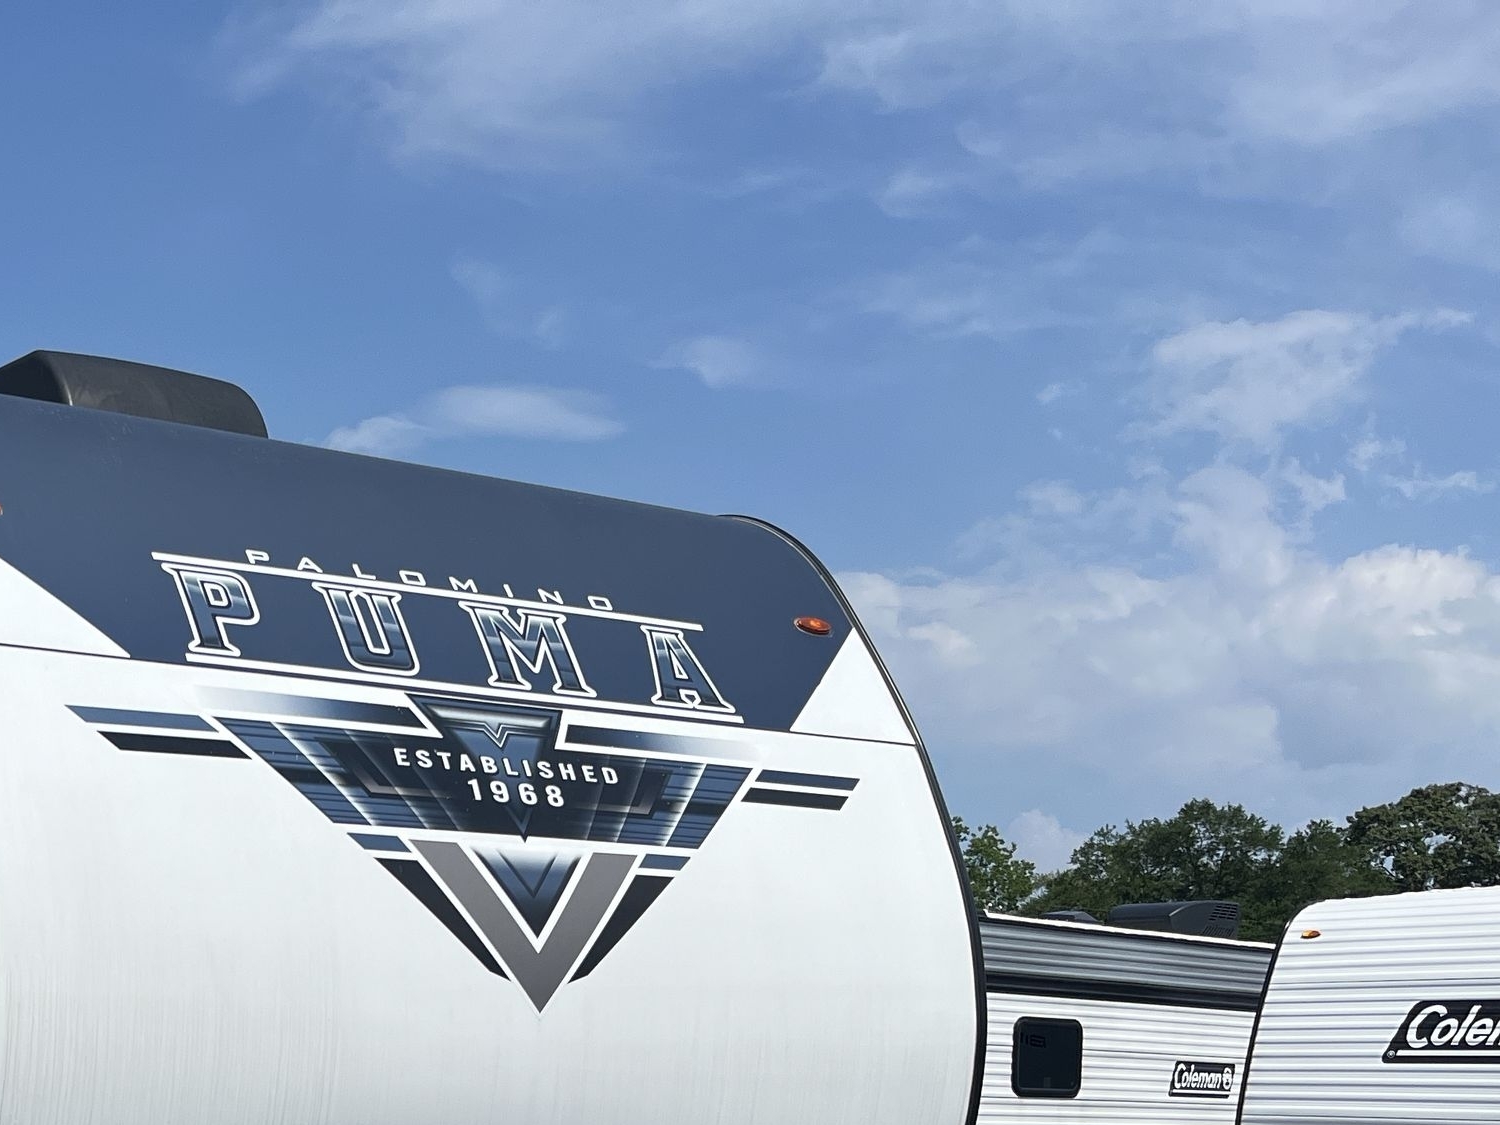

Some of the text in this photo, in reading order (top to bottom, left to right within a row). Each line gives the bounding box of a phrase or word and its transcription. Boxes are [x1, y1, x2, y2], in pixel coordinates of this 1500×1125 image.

[244, 549, 613, 612] PALOMINO
[160, 562, 737, 714] PUMA
[393, 747, 620, 786] ESTABLISHED
[467, 778, 566, 809] 1968
[1174, 1063, 1222, 1089] Coleman
